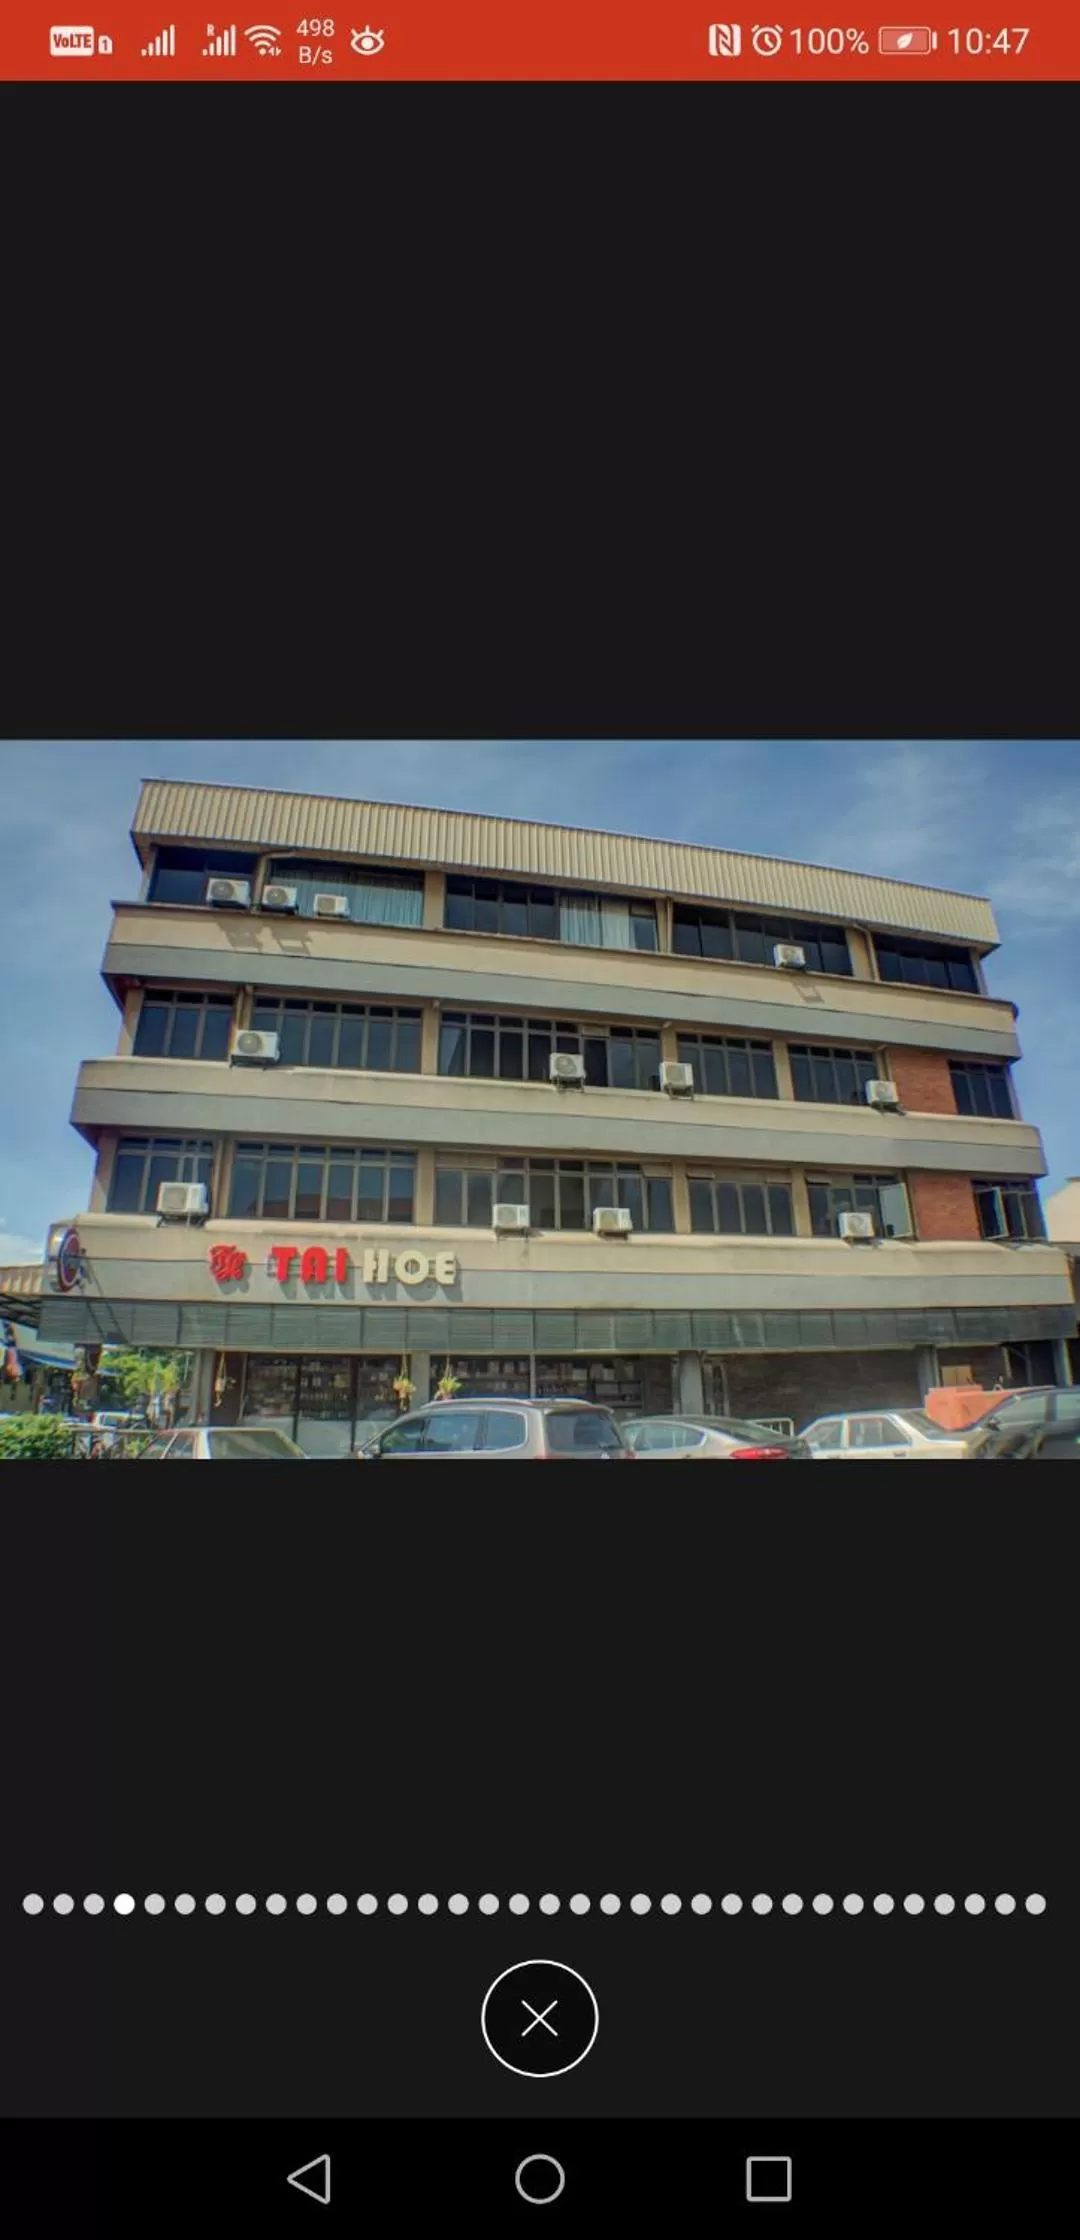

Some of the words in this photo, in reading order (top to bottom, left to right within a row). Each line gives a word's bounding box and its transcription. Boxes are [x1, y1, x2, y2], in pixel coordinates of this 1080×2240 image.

[296, 19, 335, 37] 498
[52, 33, 92, 49] VoLTE
[790, 28, 870, 55] 100%
[948, 28, 1030, 55] 10:47
[298, 46, 333, 65] B/s
[271, 1244, 348, 1284] TAI
[362, 1247, 456, 1285] HOE
